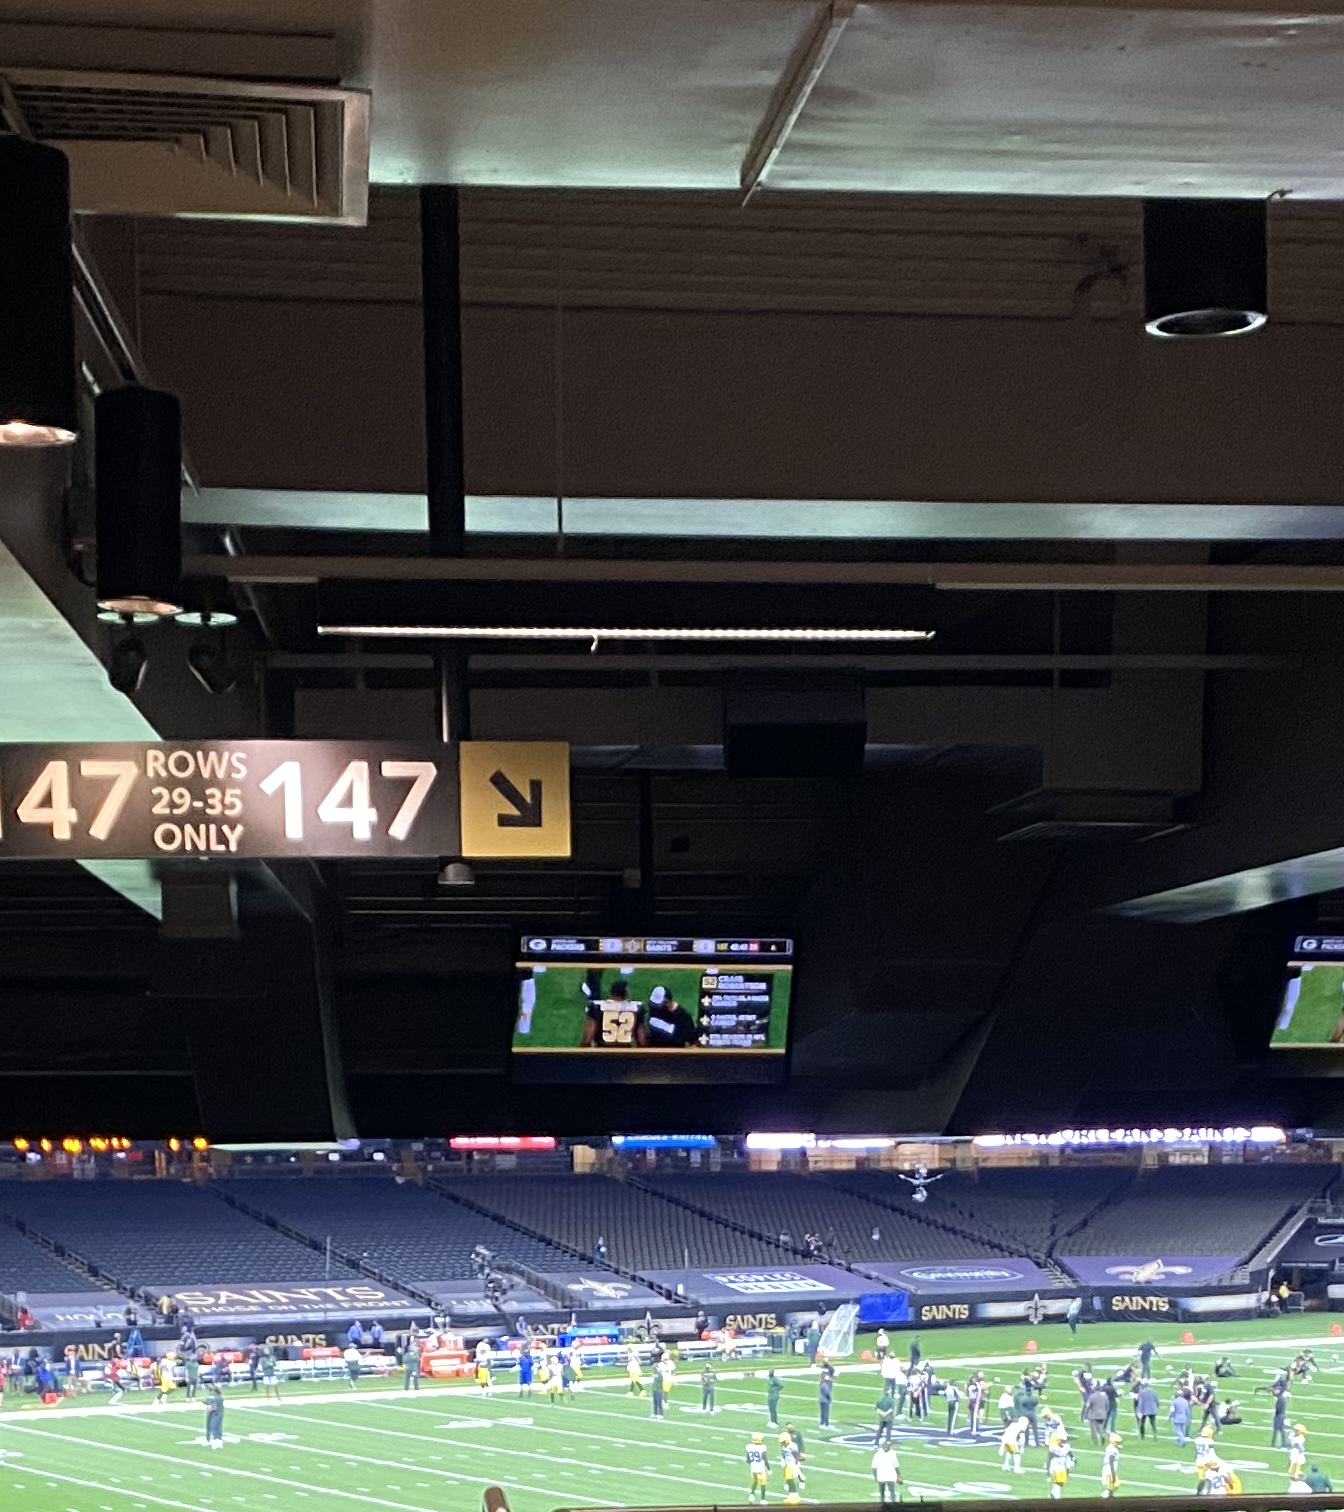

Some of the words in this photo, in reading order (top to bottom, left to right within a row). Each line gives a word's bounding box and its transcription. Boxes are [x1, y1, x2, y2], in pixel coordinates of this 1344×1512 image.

[146, 748, 249, 779] ROWS
[150, 785, 244, 817] 29-35
[259, 760, 439, 841] 147
[153, 822, 245, 854] ONLY
[602, 1010, 636, 1043] 52
[174, 1286, 386, 1306] SAINTS
[920, 1303, 970, 1320] SAINTS
[1112, 1295, 1170, 1312] SAINTS
[725, 1313, 777, 1330] SAINTS
